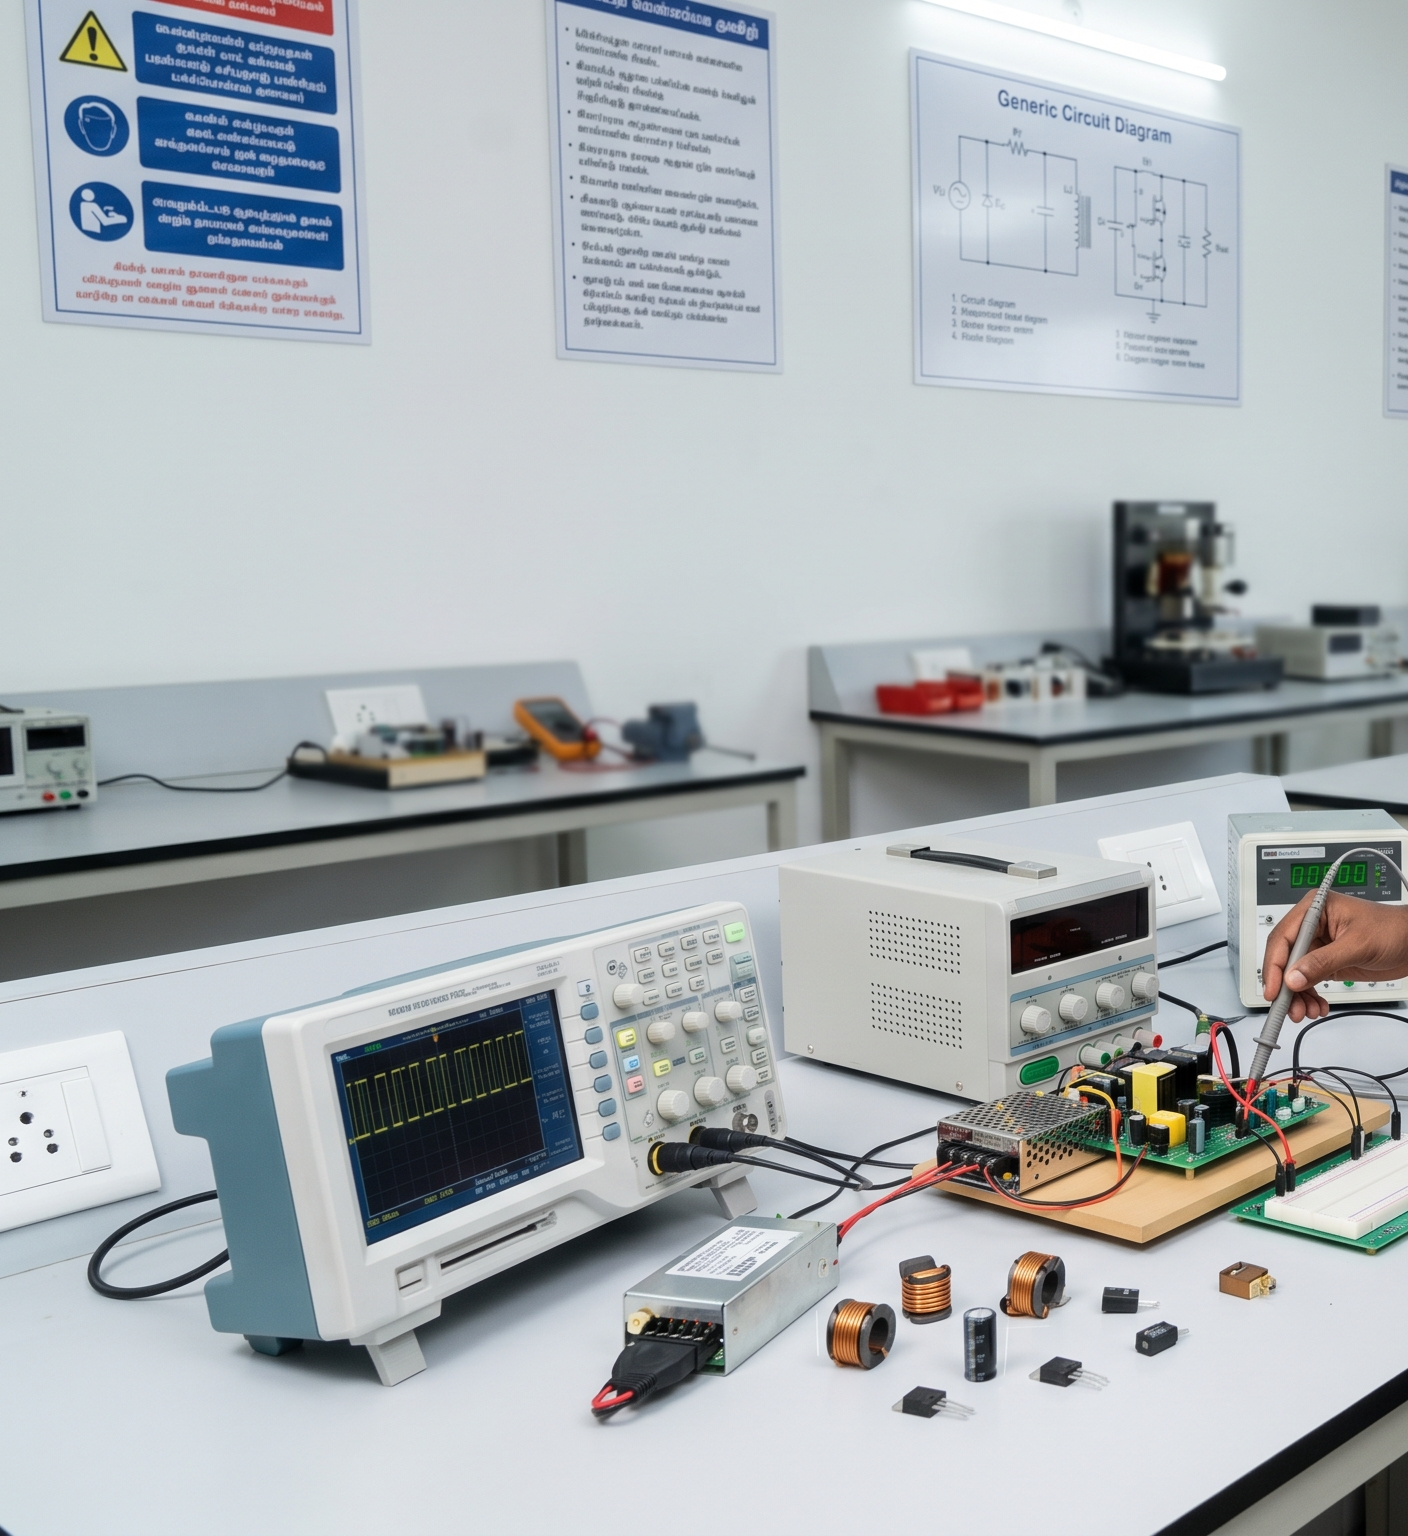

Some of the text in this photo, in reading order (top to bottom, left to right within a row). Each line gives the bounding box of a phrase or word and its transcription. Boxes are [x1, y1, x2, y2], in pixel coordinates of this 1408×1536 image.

[997, 89, 1172, 144] Generic Circuit Diagram
[1291, 864, 1366, 886] 0000
